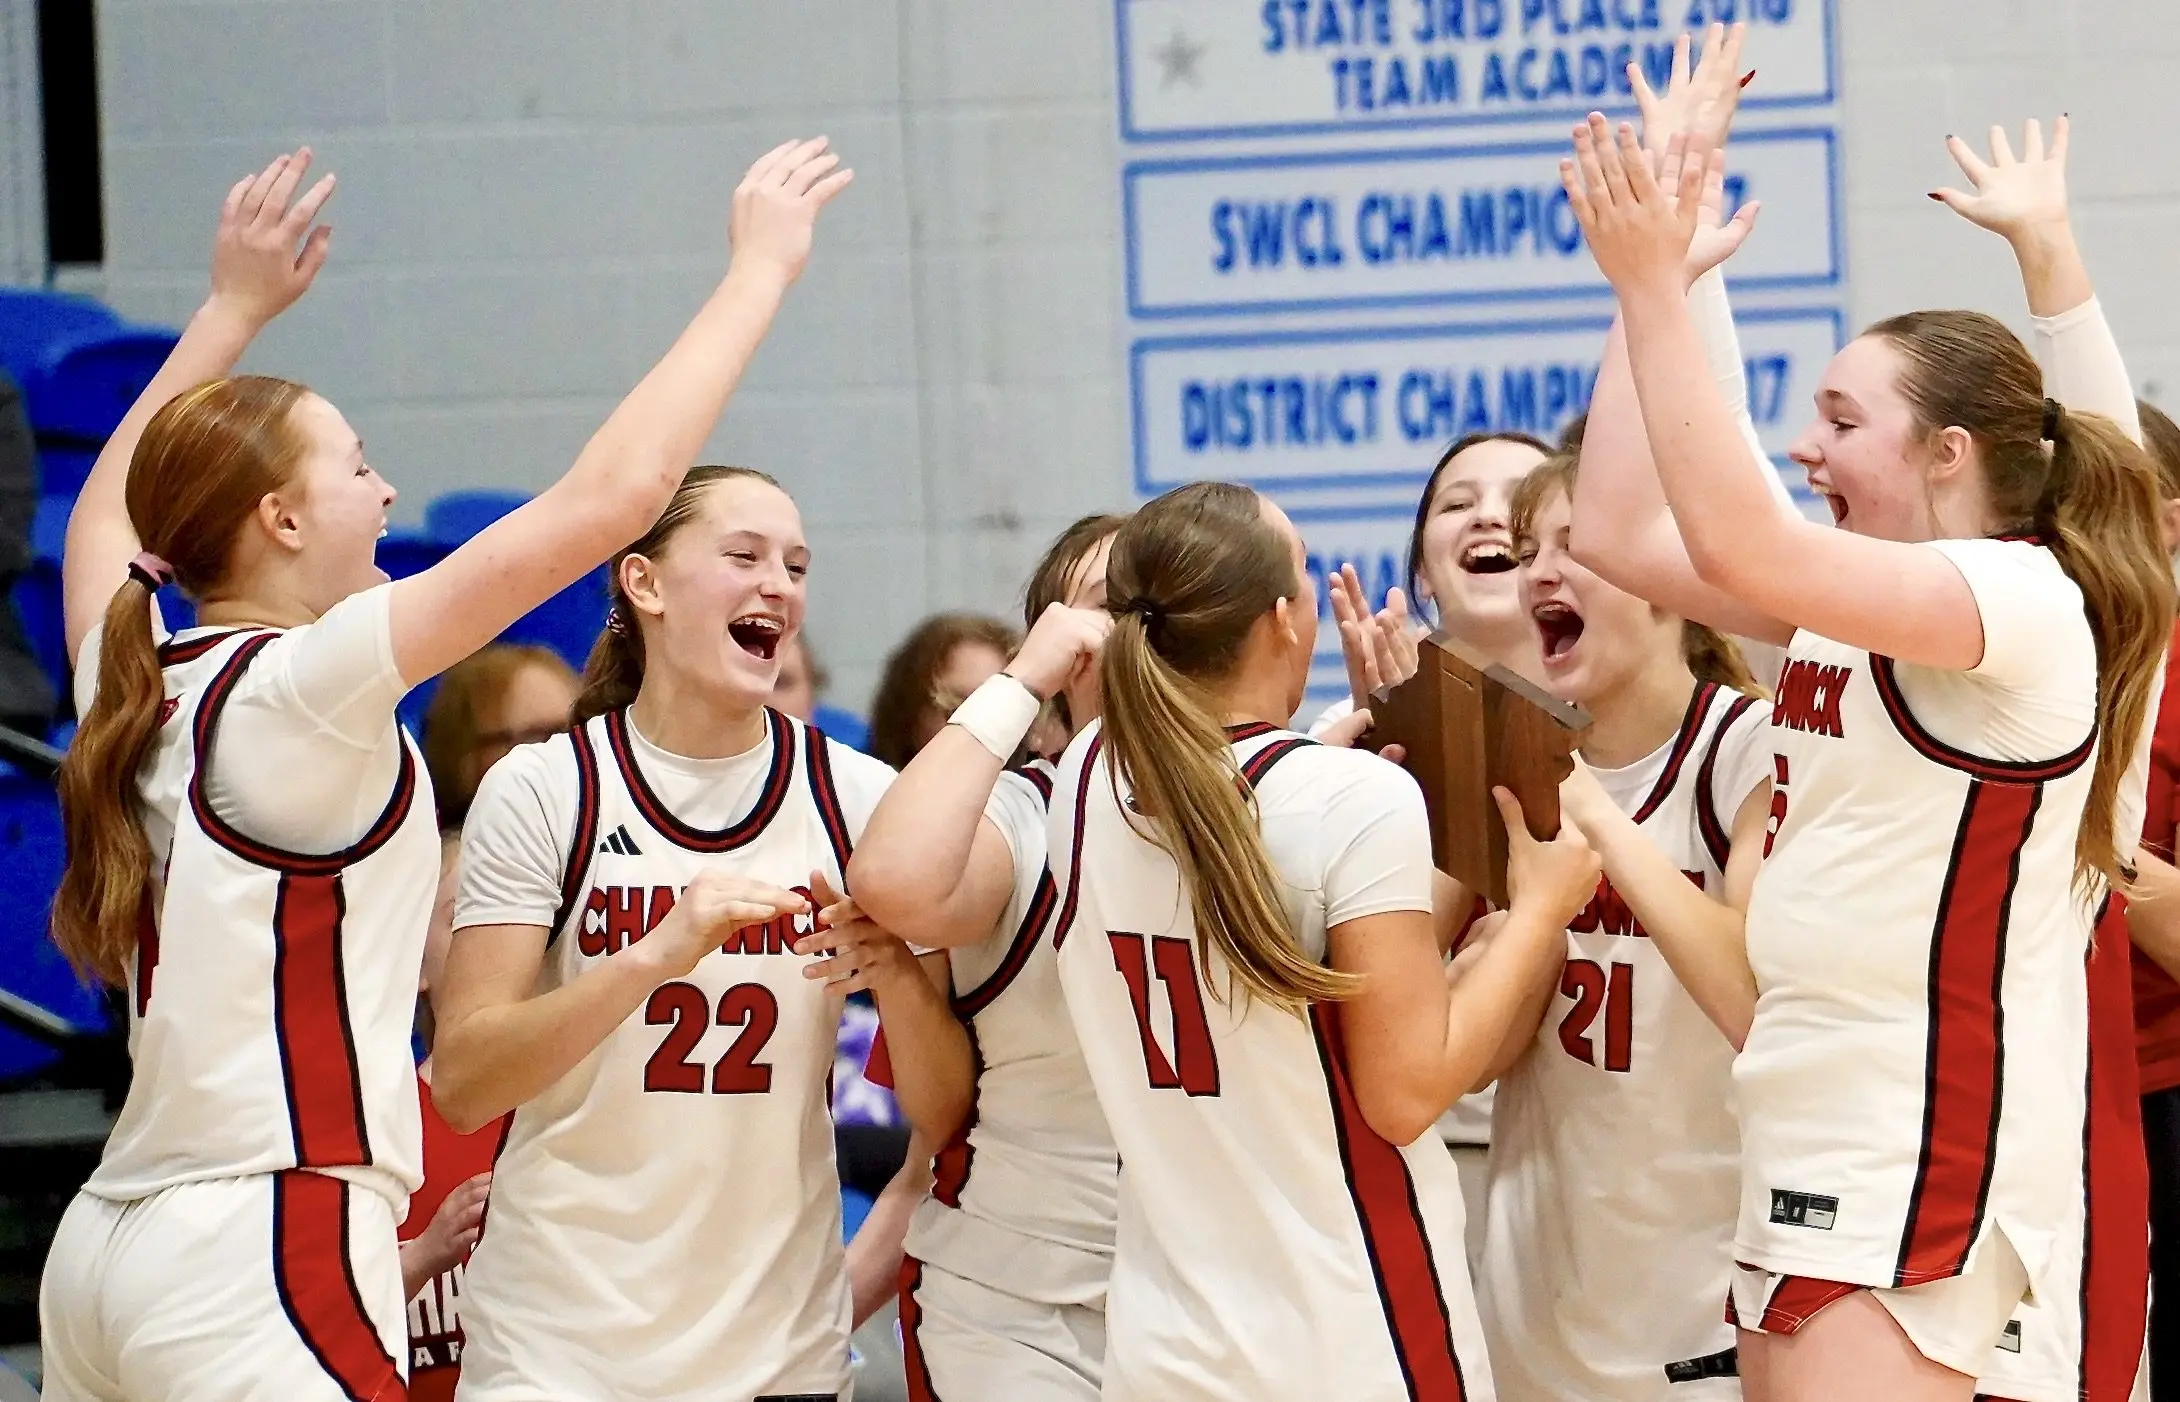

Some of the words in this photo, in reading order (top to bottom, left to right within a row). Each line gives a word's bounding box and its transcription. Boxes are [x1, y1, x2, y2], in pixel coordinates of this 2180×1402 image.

[1262, 0, 1392, 52] STATE
[1413, 0, 1503, 43] 3RD
[1521, 0, 1659, 37] PLACE
[1332, 54, 1459, 112] TEAM
[1482, 42, 1701, 101] ACADEM
[1211, 197, 1344, 275] SWCL
[1355, 182, 1582, 270] CHAMPIO
[1179, 369, 1378, 454] DISTRICT
[1397, 362, 1596, 444] CHAMPI
[644, 981, 779, 1095] 22
[1104, 930, 1221, 1098] 11
[1557, 957, 1634, 1074] 21
